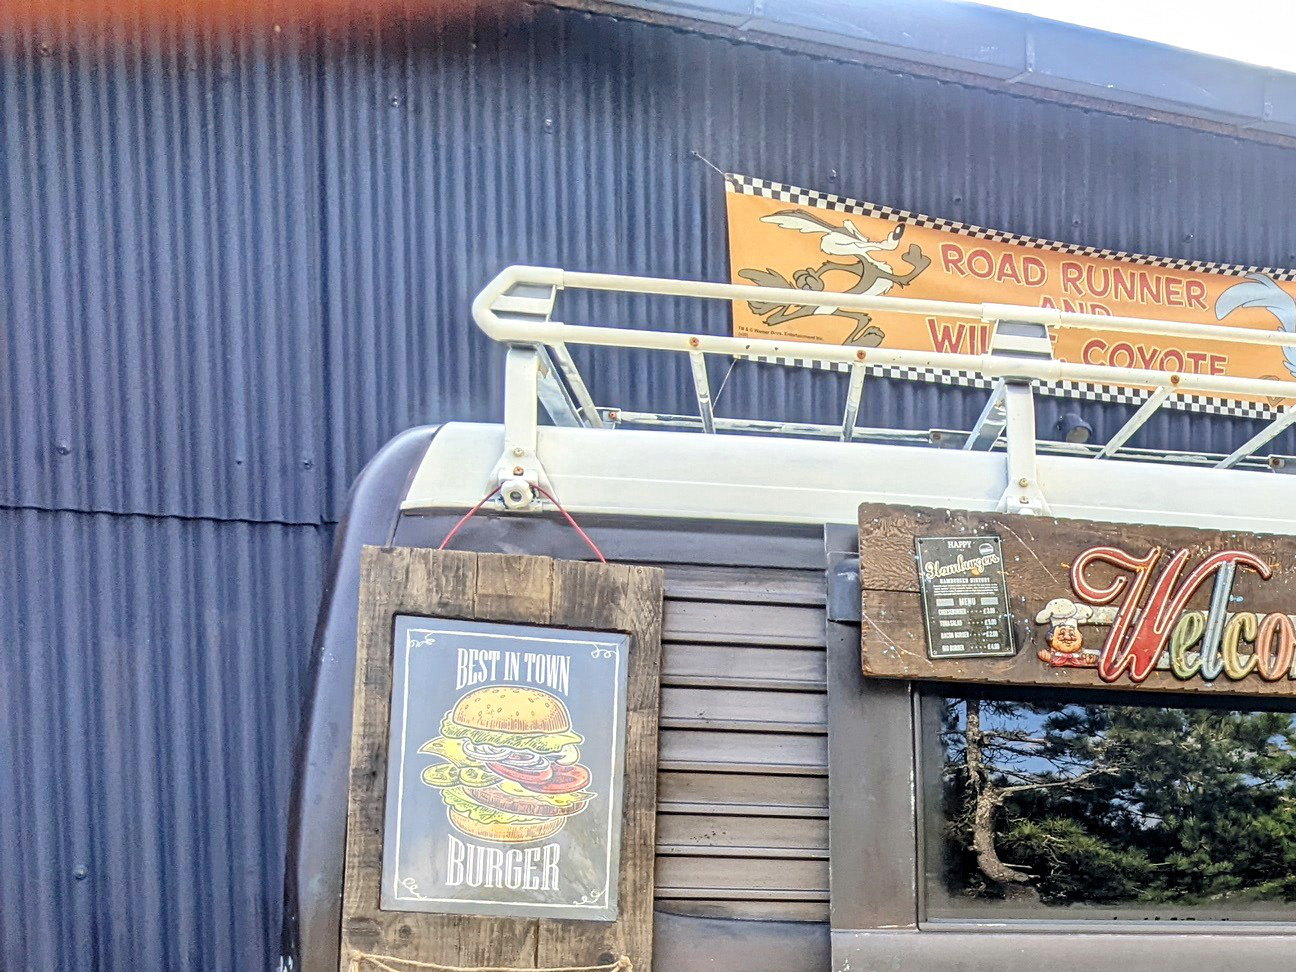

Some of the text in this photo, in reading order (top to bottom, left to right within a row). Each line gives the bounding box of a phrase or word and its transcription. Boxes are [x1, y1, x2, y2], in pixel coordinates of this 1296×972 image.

[940, 242, 1048, 287] ROAD
[1062, 260, 1209, 311] RUNNER
[948, 541, 971, 549] HAPPY
[925, 553, 1000, 580] Hamburgers
[959, 597, 976, 606] MENU
[456, 648, 571, 696] BEST IN TOWN
[445, 833, 561, 891] BURGER
